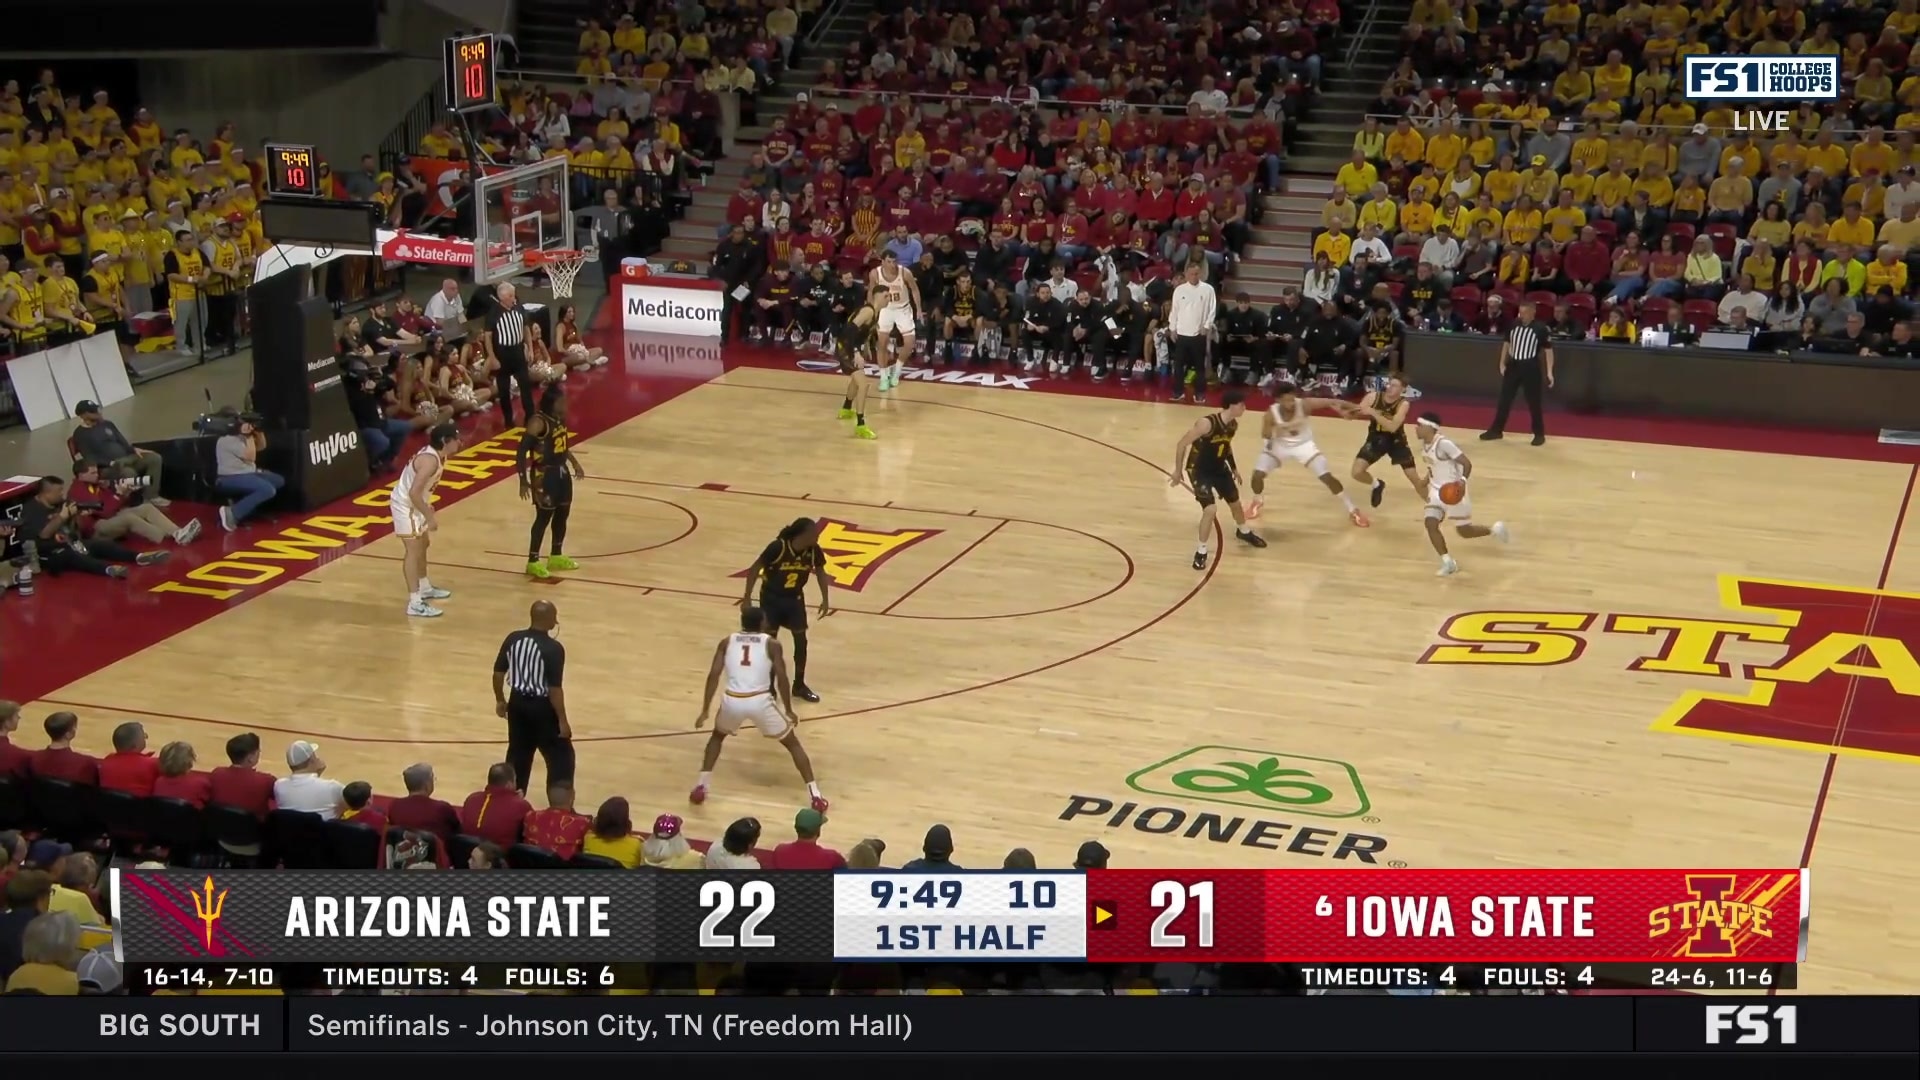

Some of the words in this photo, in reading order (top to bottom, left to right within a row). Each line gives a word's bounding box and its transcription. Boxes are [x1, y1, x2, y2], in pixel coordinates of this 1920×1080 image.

[461, 42, 485, 62] 9:49
[465, 64, 483, 98] 10
[282, 152, 309, 167] 9:49
[288, 168, 305, 187] 10
[628, 298, 721, 321] Mediacom
[307, 356, 336, 372] Mediacom
[148, 513, 392, 600] IOWA
[784, 572, 799, 589] 2
[740, 644, 752, 667] 1
[1058, 794, 1388, 865] PIONEER
